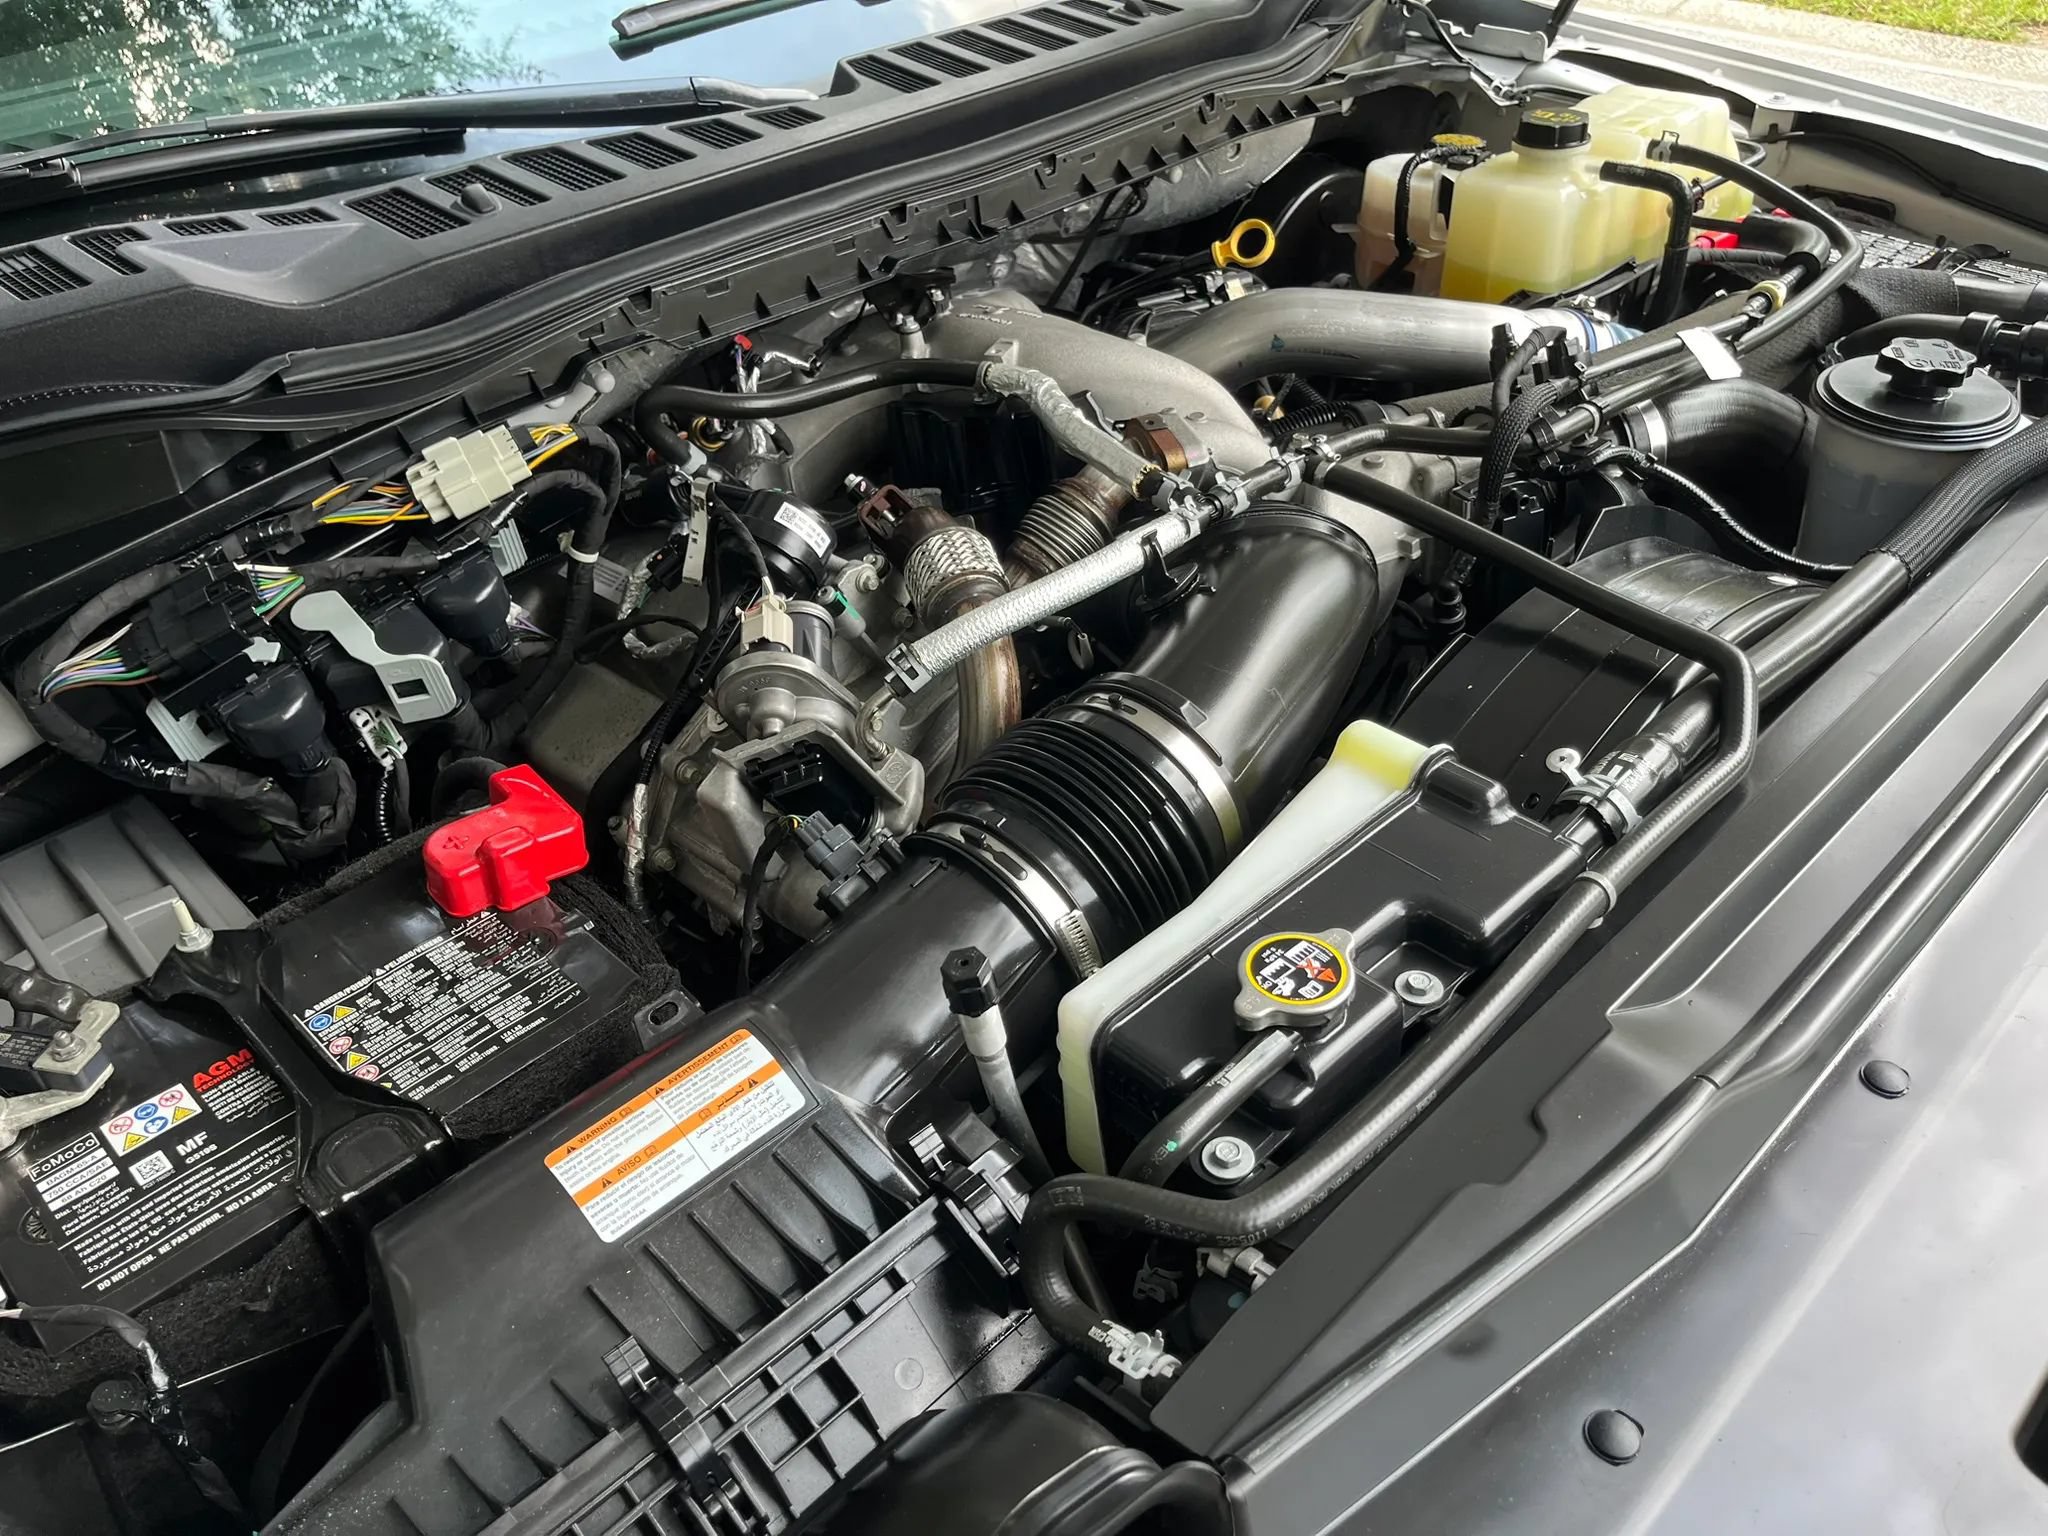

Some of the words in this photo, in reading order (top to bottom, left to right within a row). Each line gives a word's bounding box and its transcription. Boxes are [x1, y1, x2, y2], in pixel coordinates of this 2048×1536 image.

[384, 936, 444, 970] PELIGRO/VENENO
[313, 975, 373, 1011] DANGER/POISON
[192, 1048, 253, 1089] AGM
[382, 1058, 397, 1068] REACH
[389, 1050, 398, 1058] OUT
[667, 1042, 730, 1085] AVERTISSEMENT
[196, 1058, 255, 1093] TECHNOLOGY
[212, 1101, 227, 1111] ANTI
[215, 1100, 242, 1116] CONTRA
[176, 1131, 208, 1156] MF
[577, 1116, 617, 1144] WARNING
[31, 1138, 95, 1178] FoMoCo
[616, 1155, 642, 1177] AVISO
[48, 1186, 63, 1198] 750
[66, 1161, 108, 1188] CCA/SAE
[74, 1187, 87, 1195] Ah
[89, 1174, 107, 1188] C20
[585, 1201, 600, 1212] Para
[600, 1186, 620, 1203] reducir
[627, 1170, 645, 1184] riesgo
[652, 1149, 676, 1166] lesiones
[54, 1209, 72, 1219] Dist.
[62, 1218, 79, 1230] Ford
[79, 1206, 99, 1220] Motor
[74, 1238, 93, 1251] Made
[101, 1224, 116, 1235] USA
[116, 1216, 131, 1226] with
[131, 1209, 141, 1217] US
[141, 1201, 154, 1211] and
[154, 1184, 183, 1203] imported
[183, 1166, 216, 1186] materials.
[109, 1231, 121, 1240] aux
[170, 1193, 183, 1202] des
[128, 1230, 139, 1238] los
[164, 1207, 177, 1216] con
[177, 1186, 212, 1208] materiales
[97, 1281, 111, 1292] DO
[111, 1268, 130, 1283] NOT
[130, 1254, 157, 1272] OPEN.
[158, 1243, 172, 1255] NE
[170, 1232, 189, 1247] PAS
[188, 1212, 224, 1236] OUVRIR.
[225, 1202, 240, 1214] NO
[239, 1195, 253, 1206] LA
[251, 1181, 278, 1199] ABRA.
